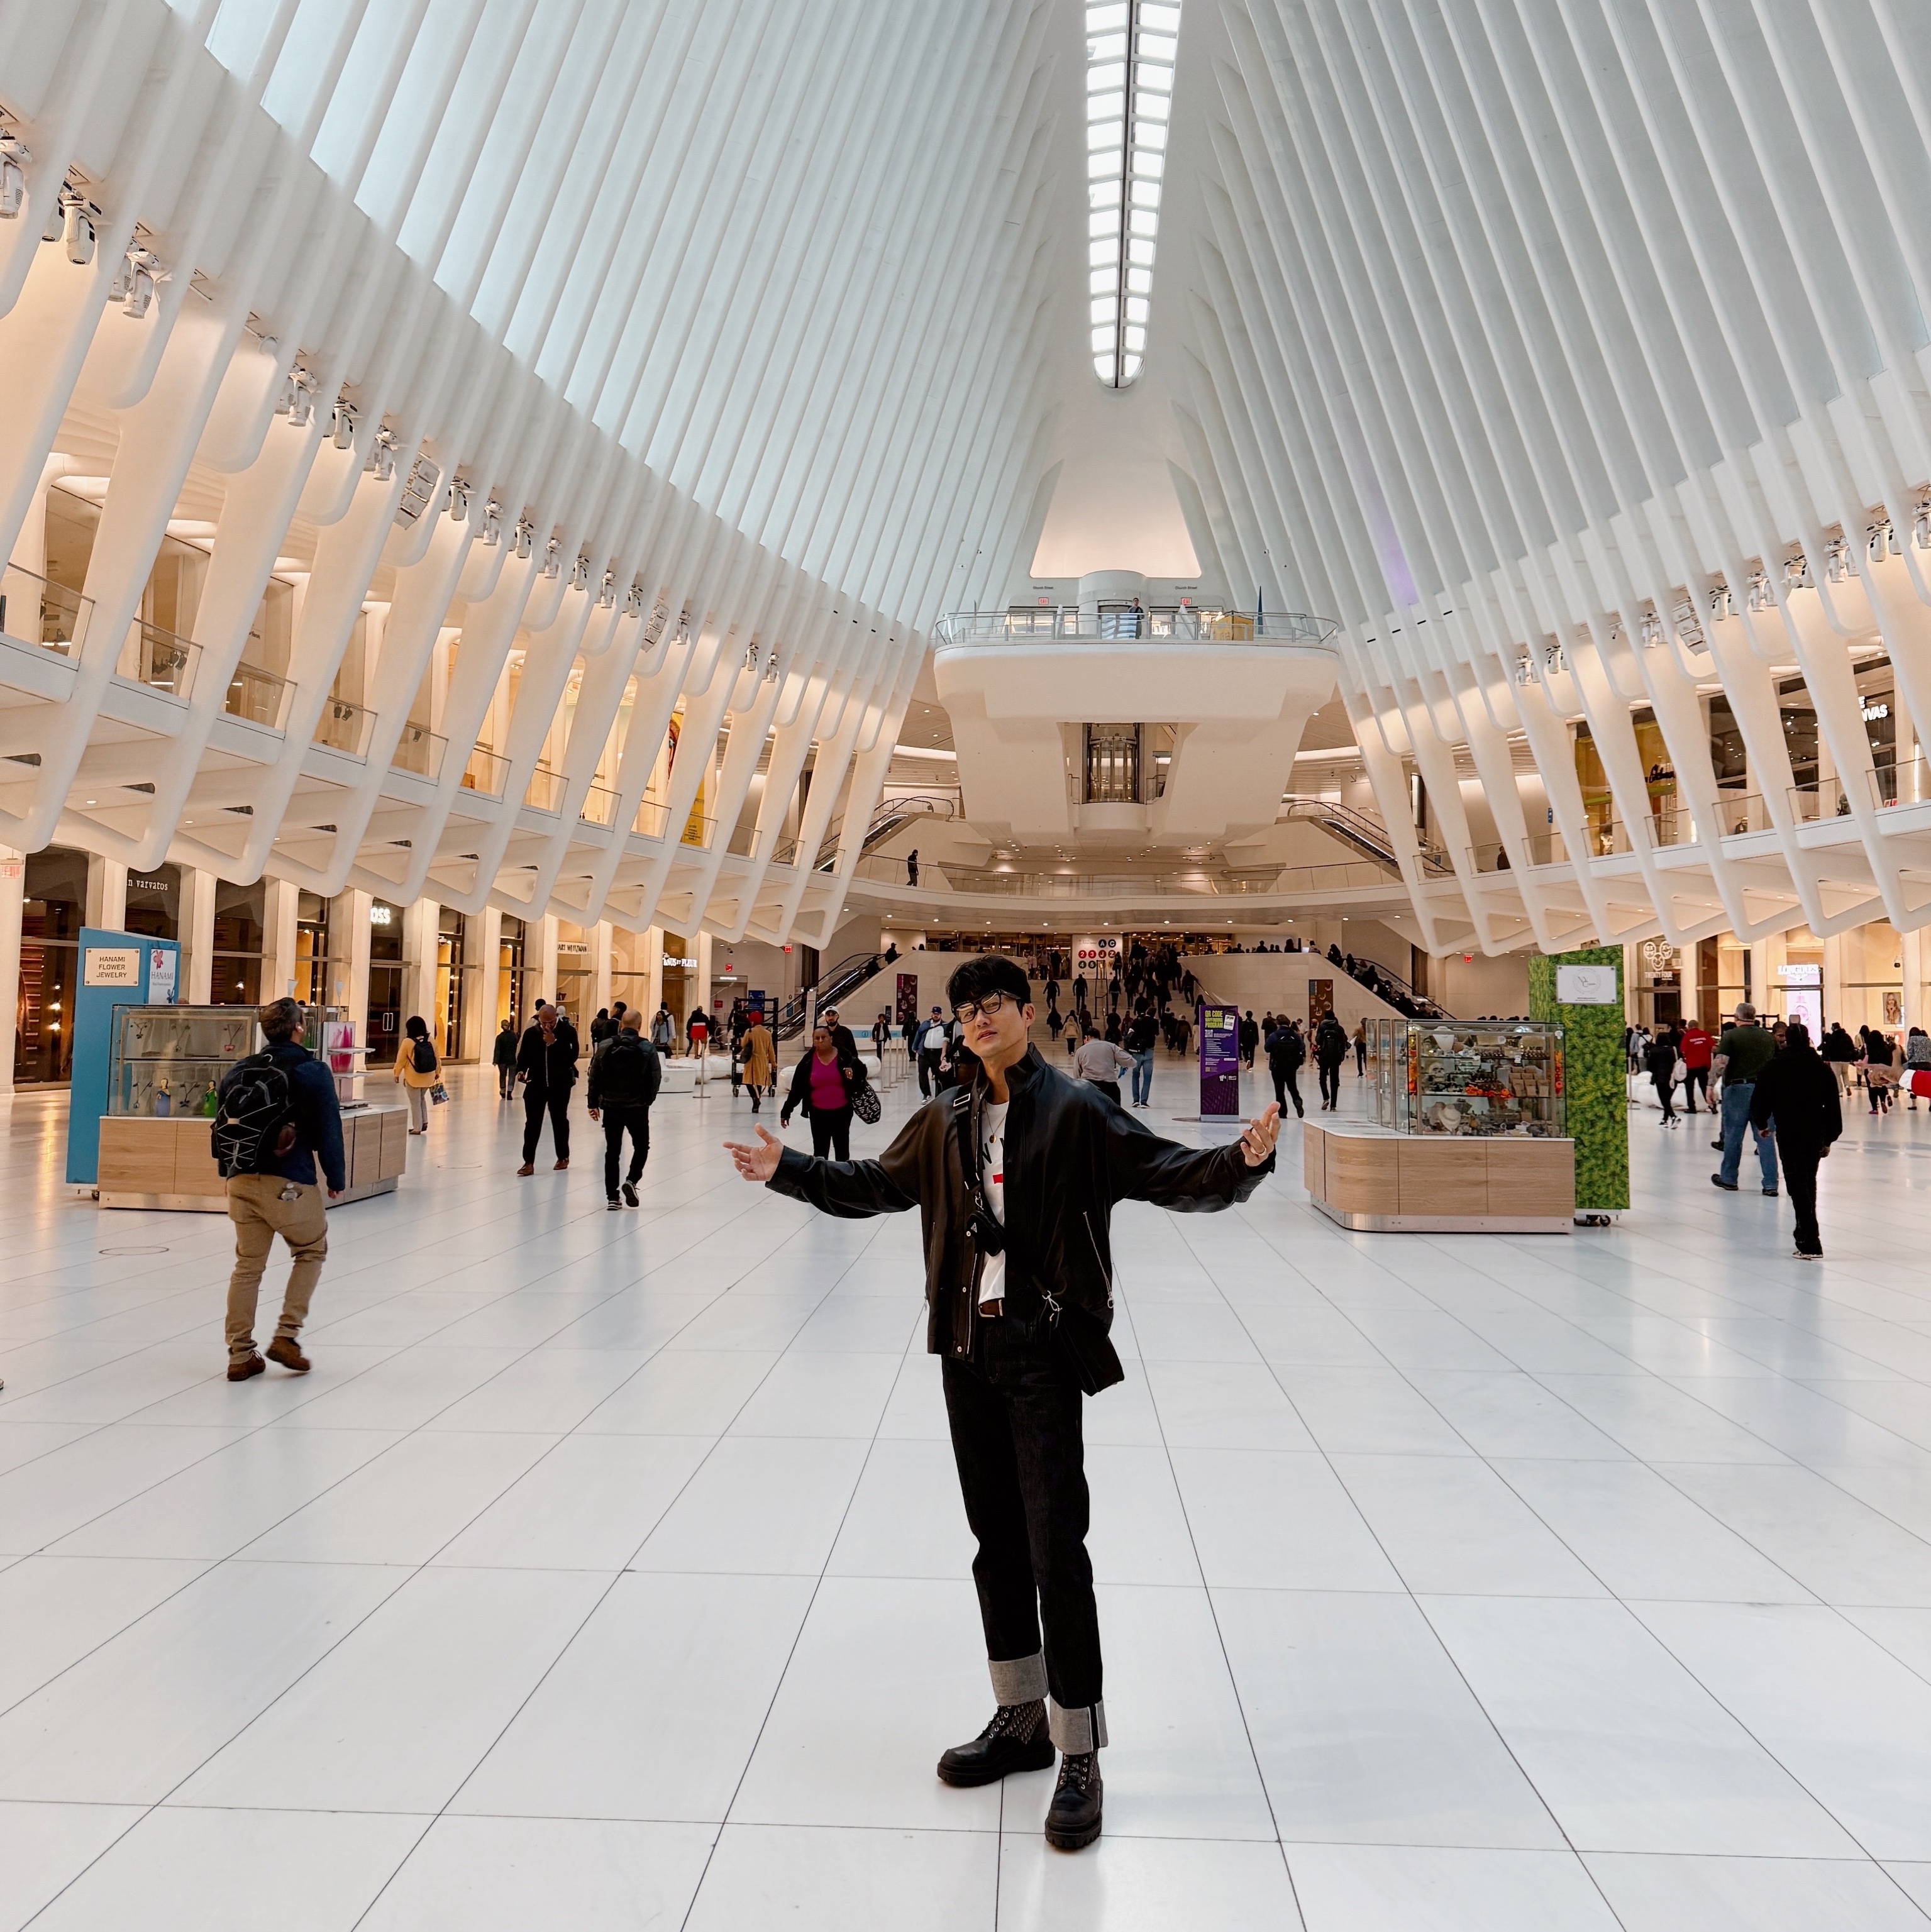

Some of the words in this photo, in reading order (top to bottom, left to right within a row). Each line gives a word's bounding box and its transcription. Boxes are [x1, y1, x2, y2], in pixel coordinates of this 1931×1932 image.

[1858, 695, 1866, 709] E
[136, 880, 168, 891] varvatos
[567, 944, 587, 952] WEITZMAN
[681, 958, 697, 968] FLEUR
[151, 971, 174, 980] HANAMI
